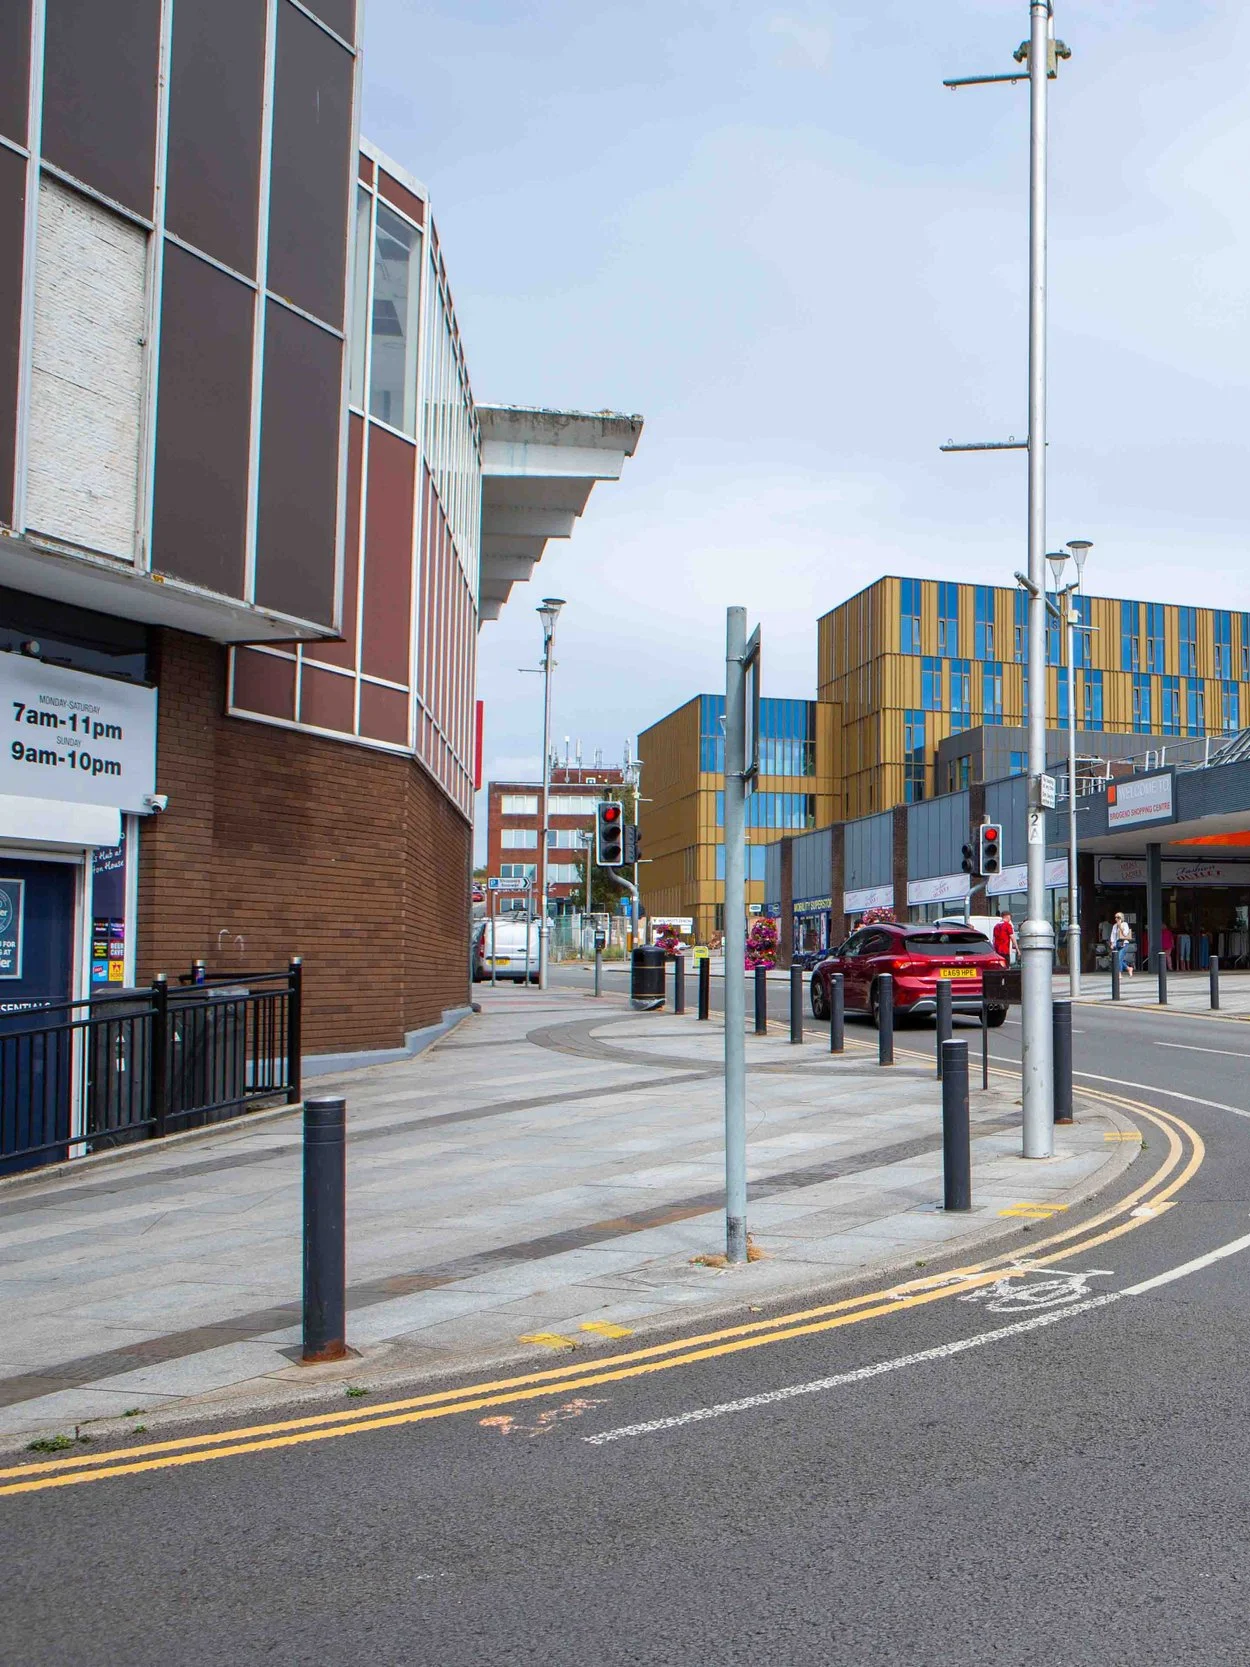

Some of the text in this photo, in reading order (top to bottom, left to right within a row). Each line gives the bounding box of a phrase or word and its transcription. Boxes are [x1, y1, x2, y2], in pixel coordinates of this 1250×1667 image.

[12, 701, 123, 740] 7am-11pm
[56, 736, 82, 748] SUNDAY
[11, 741, 122, 776] 9am-10pm
[1118, 778, 1170, 800] WELCOME TO
[1030, 813, 1039, 826] 2
[1109, 802, 1171, 820] BRIDGEND SHOPPING CENTRE
[942, 968, 975, 977] CA69 HPE
